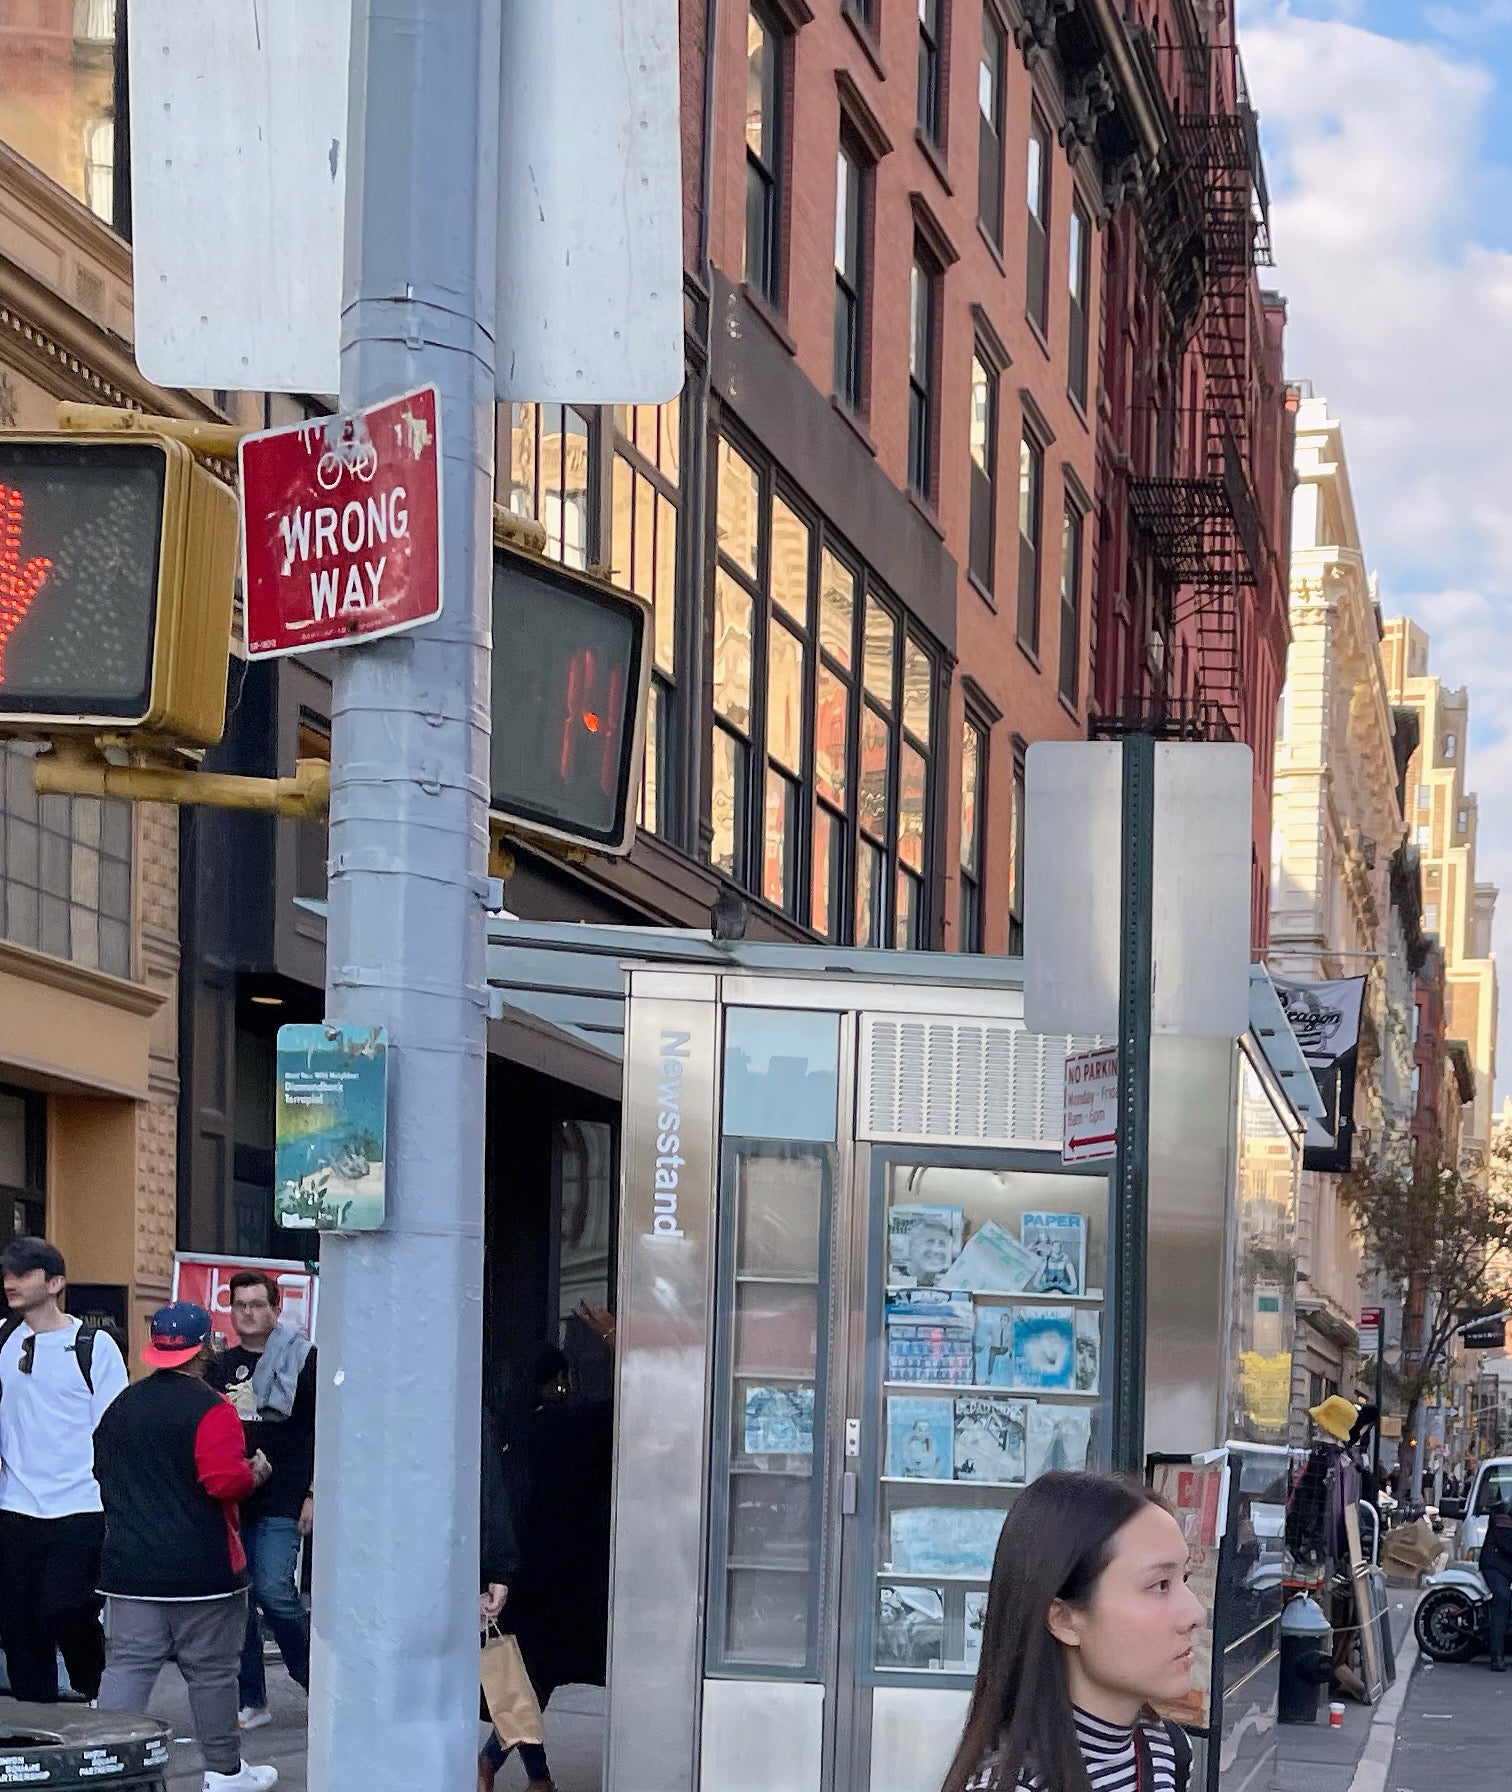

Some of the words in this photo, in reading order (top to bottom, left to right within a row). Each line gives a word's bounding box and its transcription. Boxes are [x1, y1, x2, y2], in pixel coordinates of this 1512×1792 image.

[282, 486, 408, 565] WRONG
[310, 556, 387, 621] WAY
[1068, 1065, 1081, 1085] NO
[1083, 1058, 1118, 1082] PARKIN
[653, 1029, 691, 1237] Newsstand
[1023, 1214, 1080, 1228] PAPER
